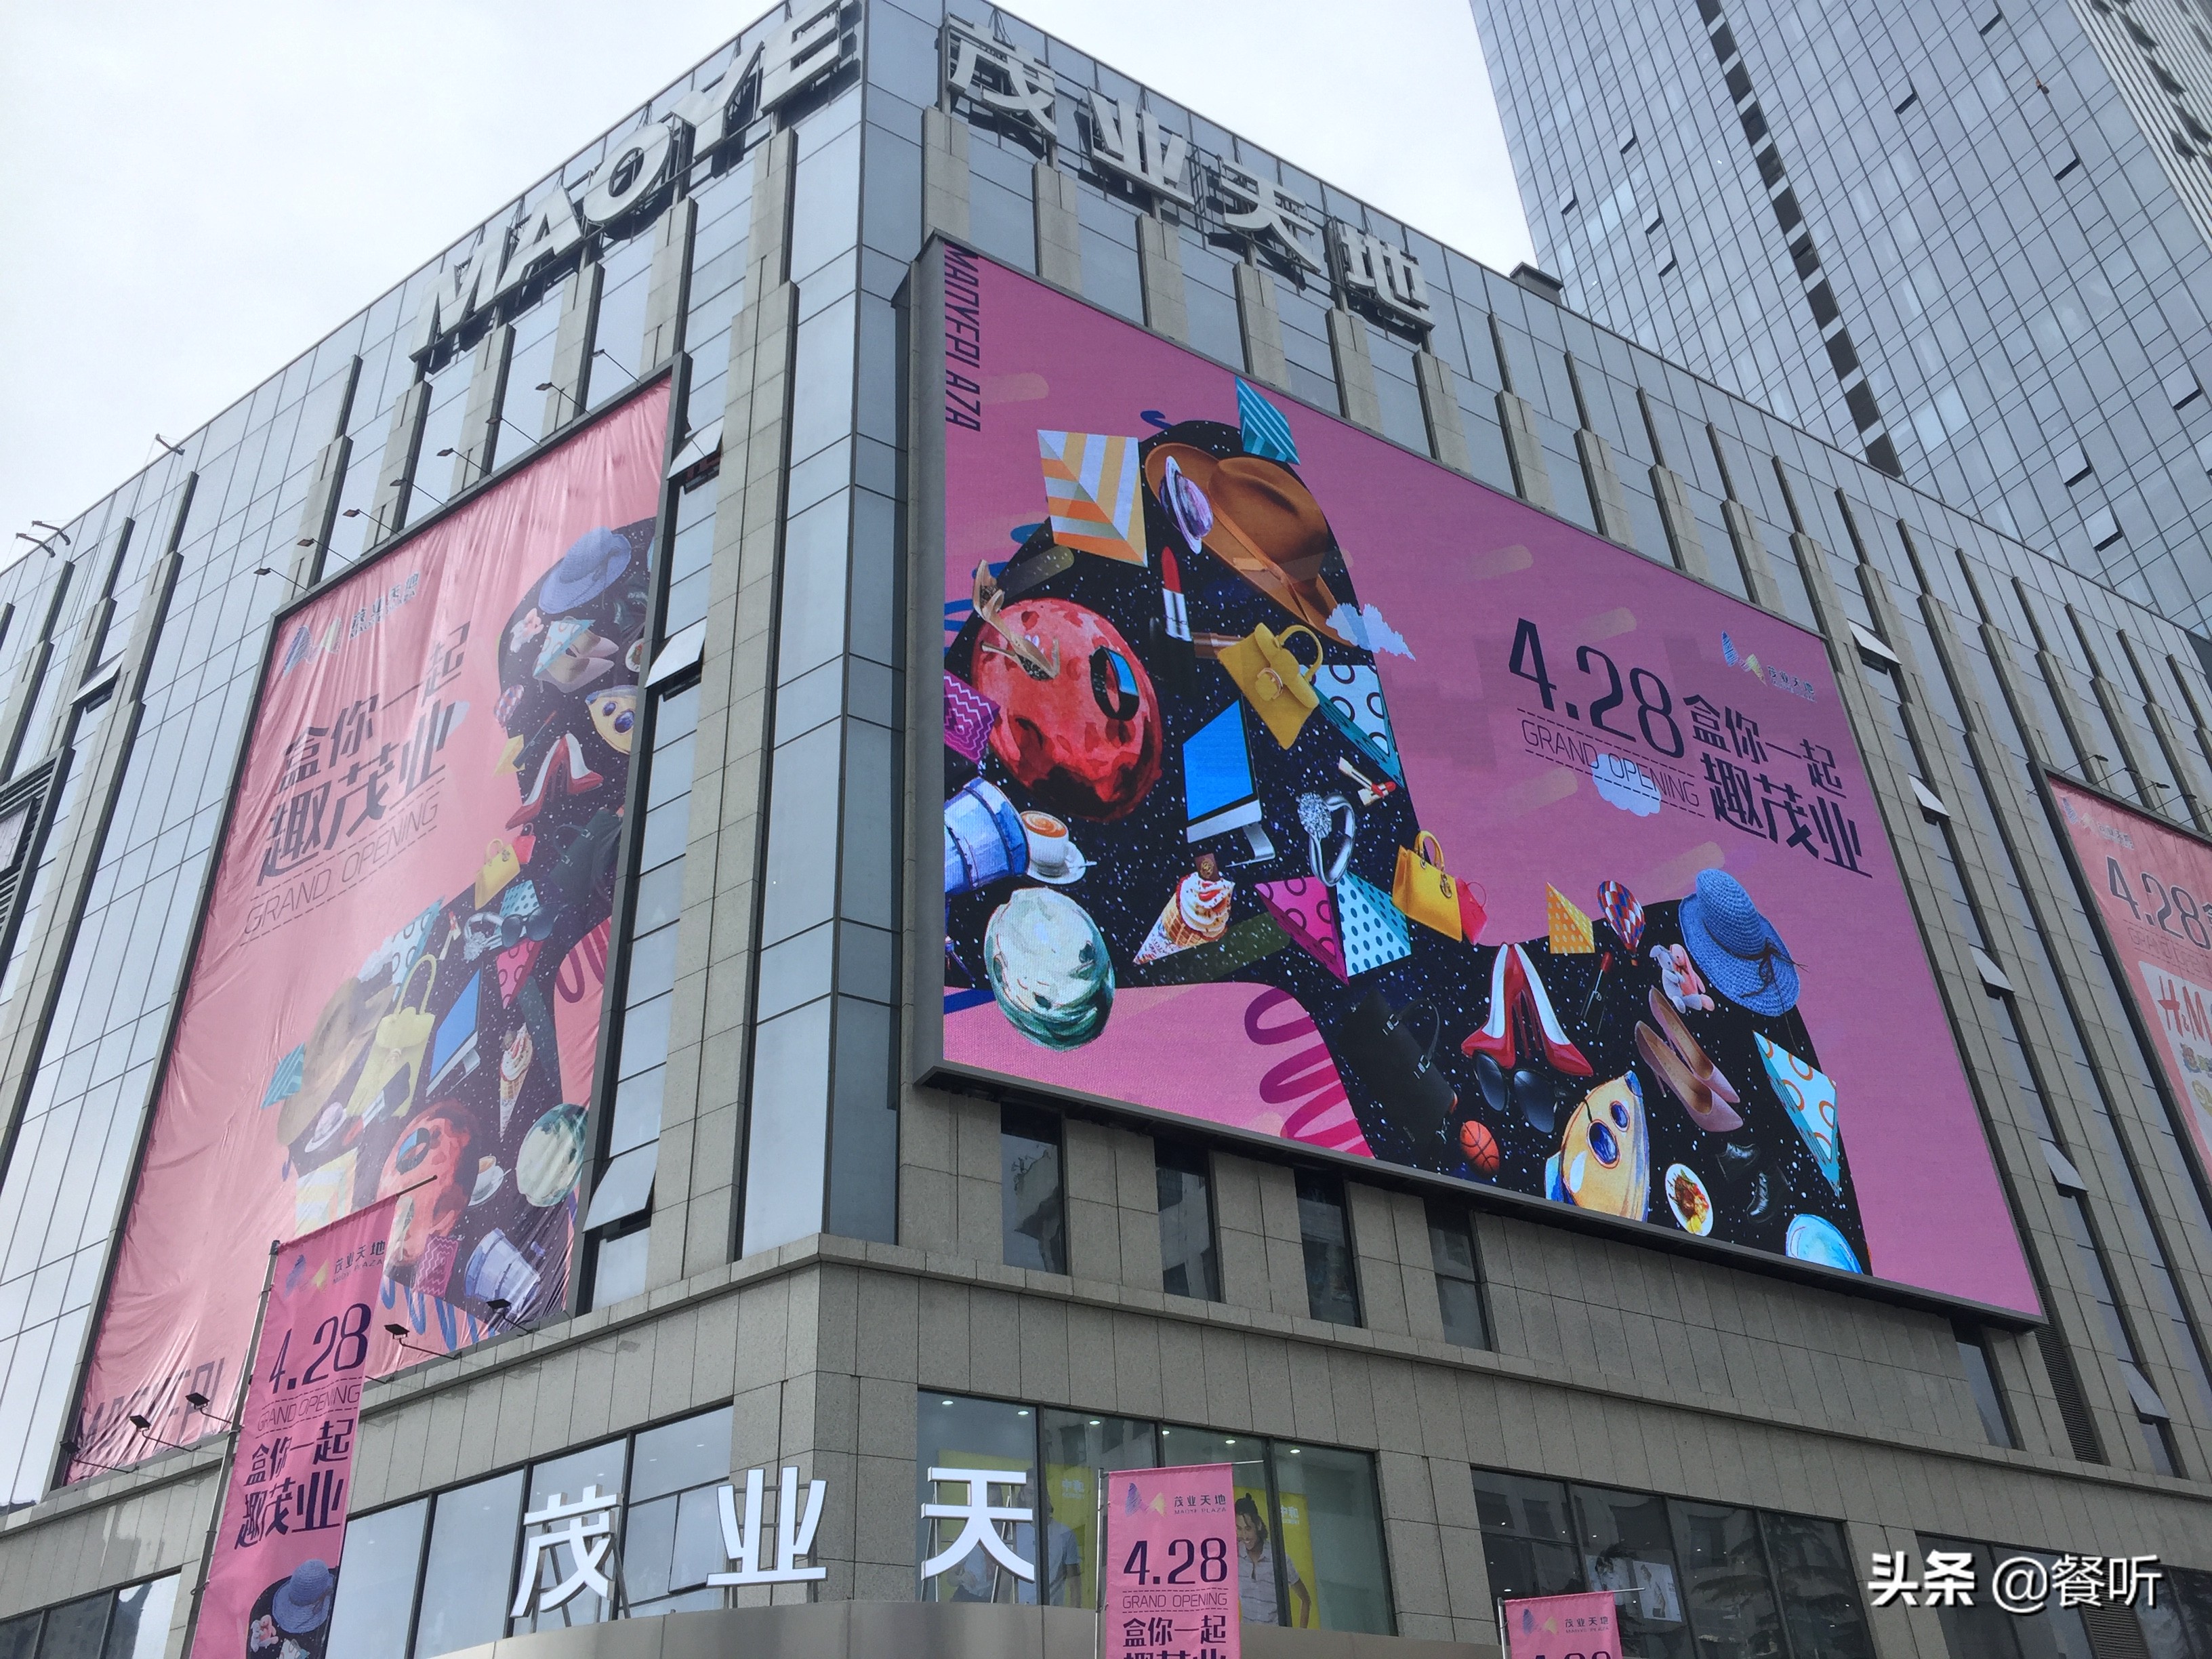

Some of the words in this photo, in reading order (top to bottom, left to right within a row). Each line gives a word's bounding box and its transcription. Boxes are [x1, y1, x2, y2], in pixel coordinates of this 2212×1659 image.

[409, 0, 842, 363] MAOYE
[949, 15, 1435, 331] 茂业天地
[278, 621, 470, 793] 盒你一起
[1509, 617, 1685, 758] 4.28
[1521, 720, 1599, 769] GRAND
[1609, 753, 1700, 807] OPENING
[1683, 694, 1846, 798] 盒你一起
[257, 699, 455, 886] 趣茂业
[1700, 752, 1872, 878] 趣茂业
[244, 866, 332, 936] GRAND
[342, 791, 439, 886] OPENING
[2106, 856, 2211, 950] 4.28
[335, 1240, 386, 1275] 茂业天地
[268, 1303, 371, 1395] 4.28
[298, 1384, 361, 1417] OPENING
[243, 1418, 354, 1487] 盒你一起
[234, 1469, 344, 1550] 趣茂业
[1174, 1494, 1226, 1508] 茂业天地
[1122, 1595, 1167, 1609] GRAND
[1172, 1593, 1228, 1608] OPENING
[1123, 1537, 1227, 1586] 4.28
[1123, 1615, 1227, 1647] 盒你一起
